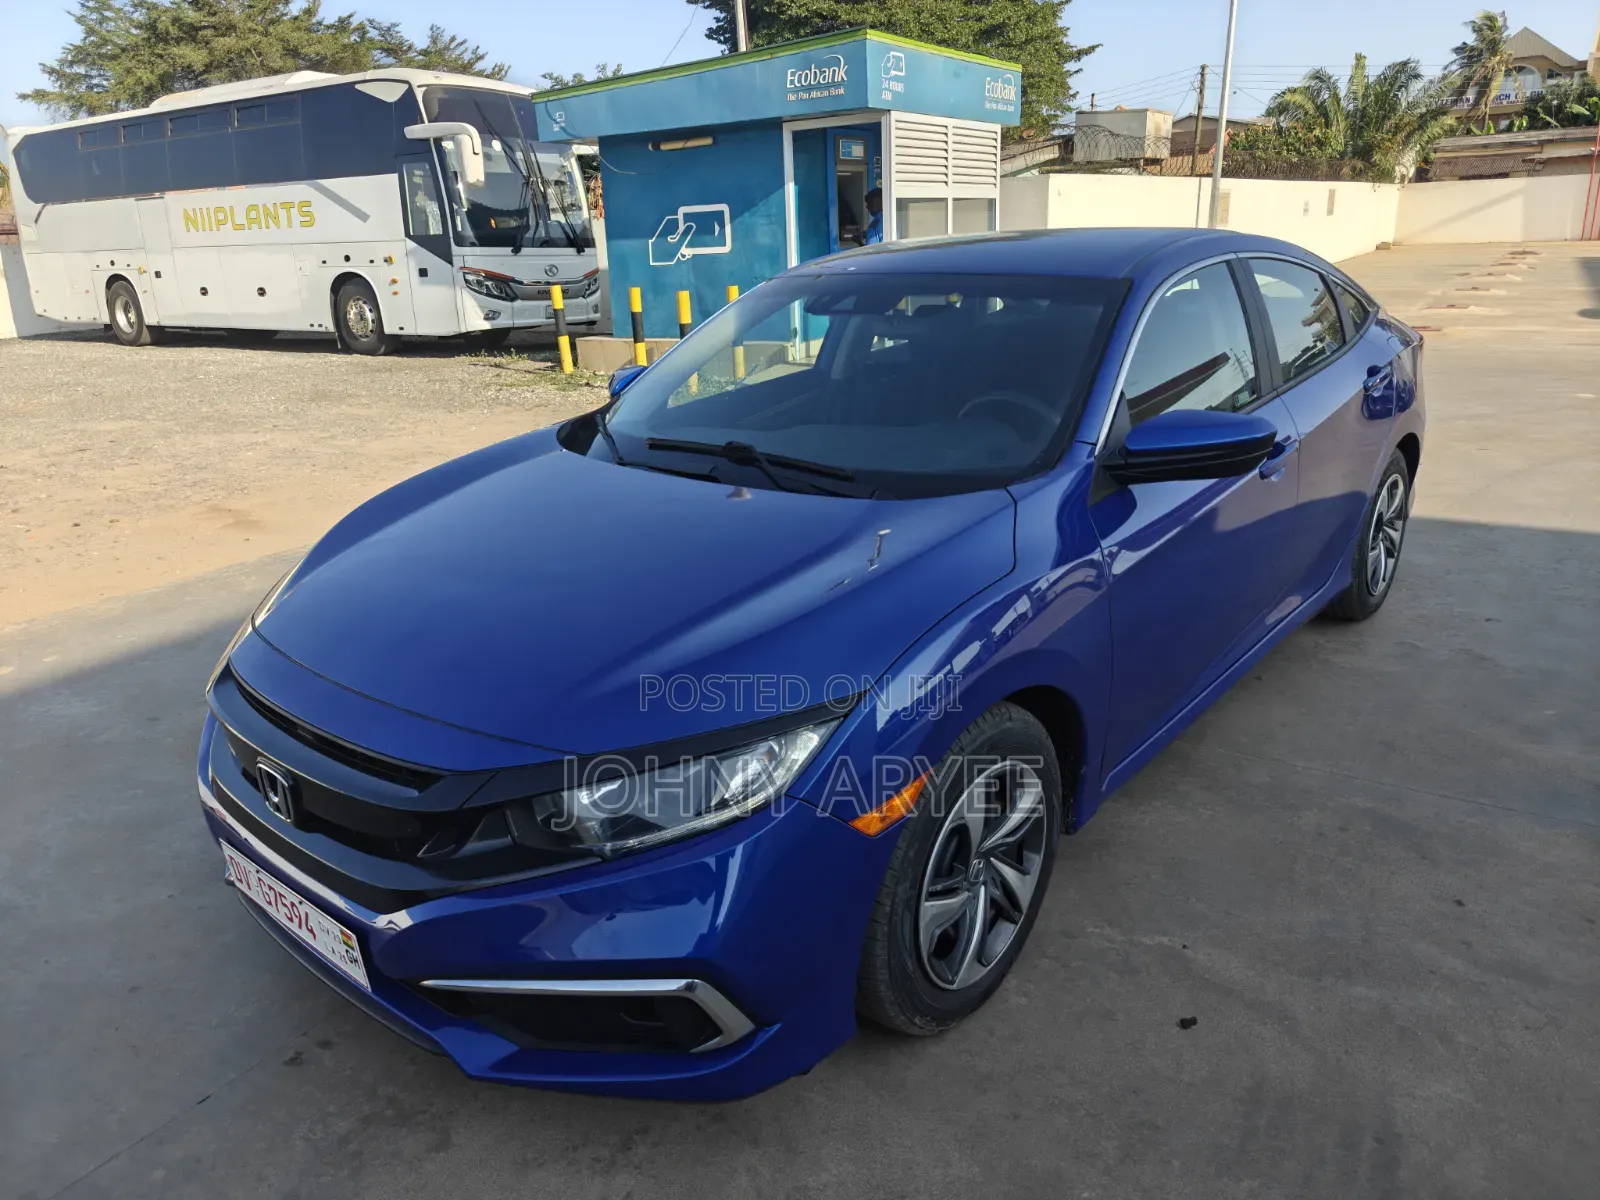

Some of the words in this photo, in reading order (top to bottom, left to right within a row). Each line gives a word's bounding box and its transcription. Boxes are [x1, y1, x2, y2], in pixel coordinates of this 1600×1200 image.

[787, 55, 848, 88] Ecobank
[830, 87, 845, 96] Bank
[985, 74, 1016, 101] Ecobank
[183, 201, 315, 232] NIIPLANTS
[228, 854, 252, 891] DV
[258, 876, 317, 941] G7594
[345, 948, 361, 970] GH
